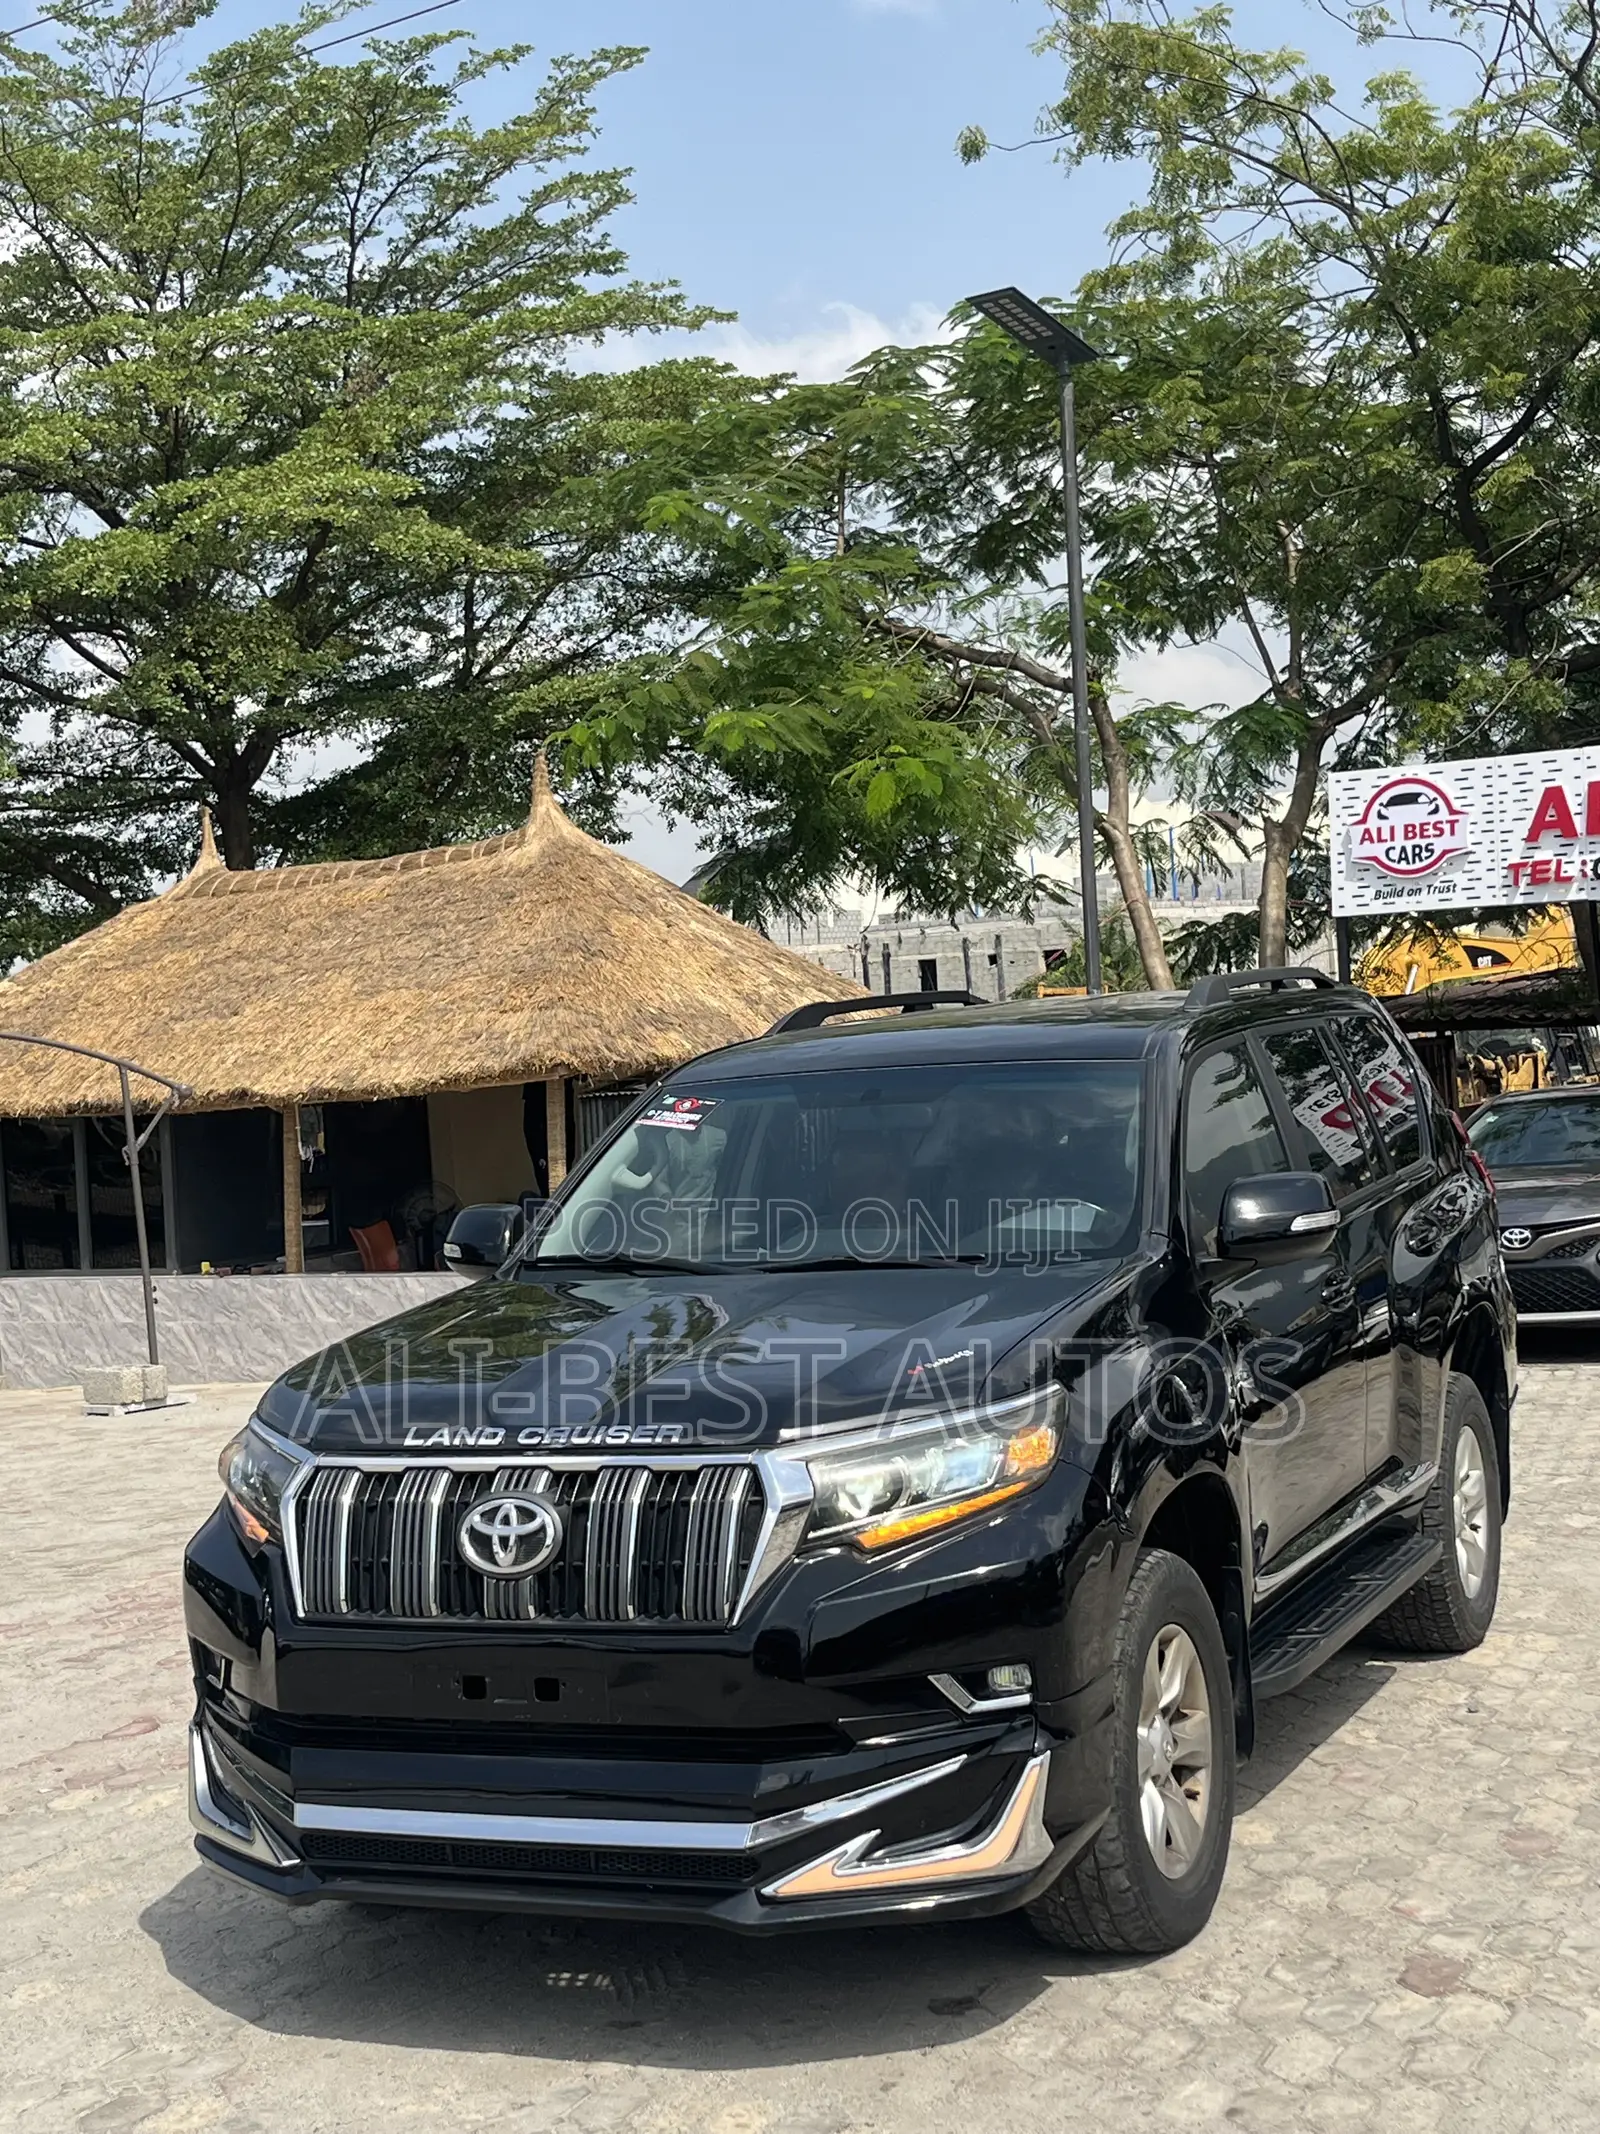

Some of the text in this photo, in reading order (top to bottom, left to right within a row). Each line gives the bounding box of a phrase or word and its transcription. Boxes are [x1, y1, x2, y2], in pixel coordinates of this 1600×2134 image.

[1359, 819, 1460, 845] ALI BEST
[1385, 842, 1435, 865] CARS
[1373, 883, 1457, 901] Build on Trust
[1477, 955, 1492, 968] CAT
[403, 1424, 683, 1447] LAND CRUISER
